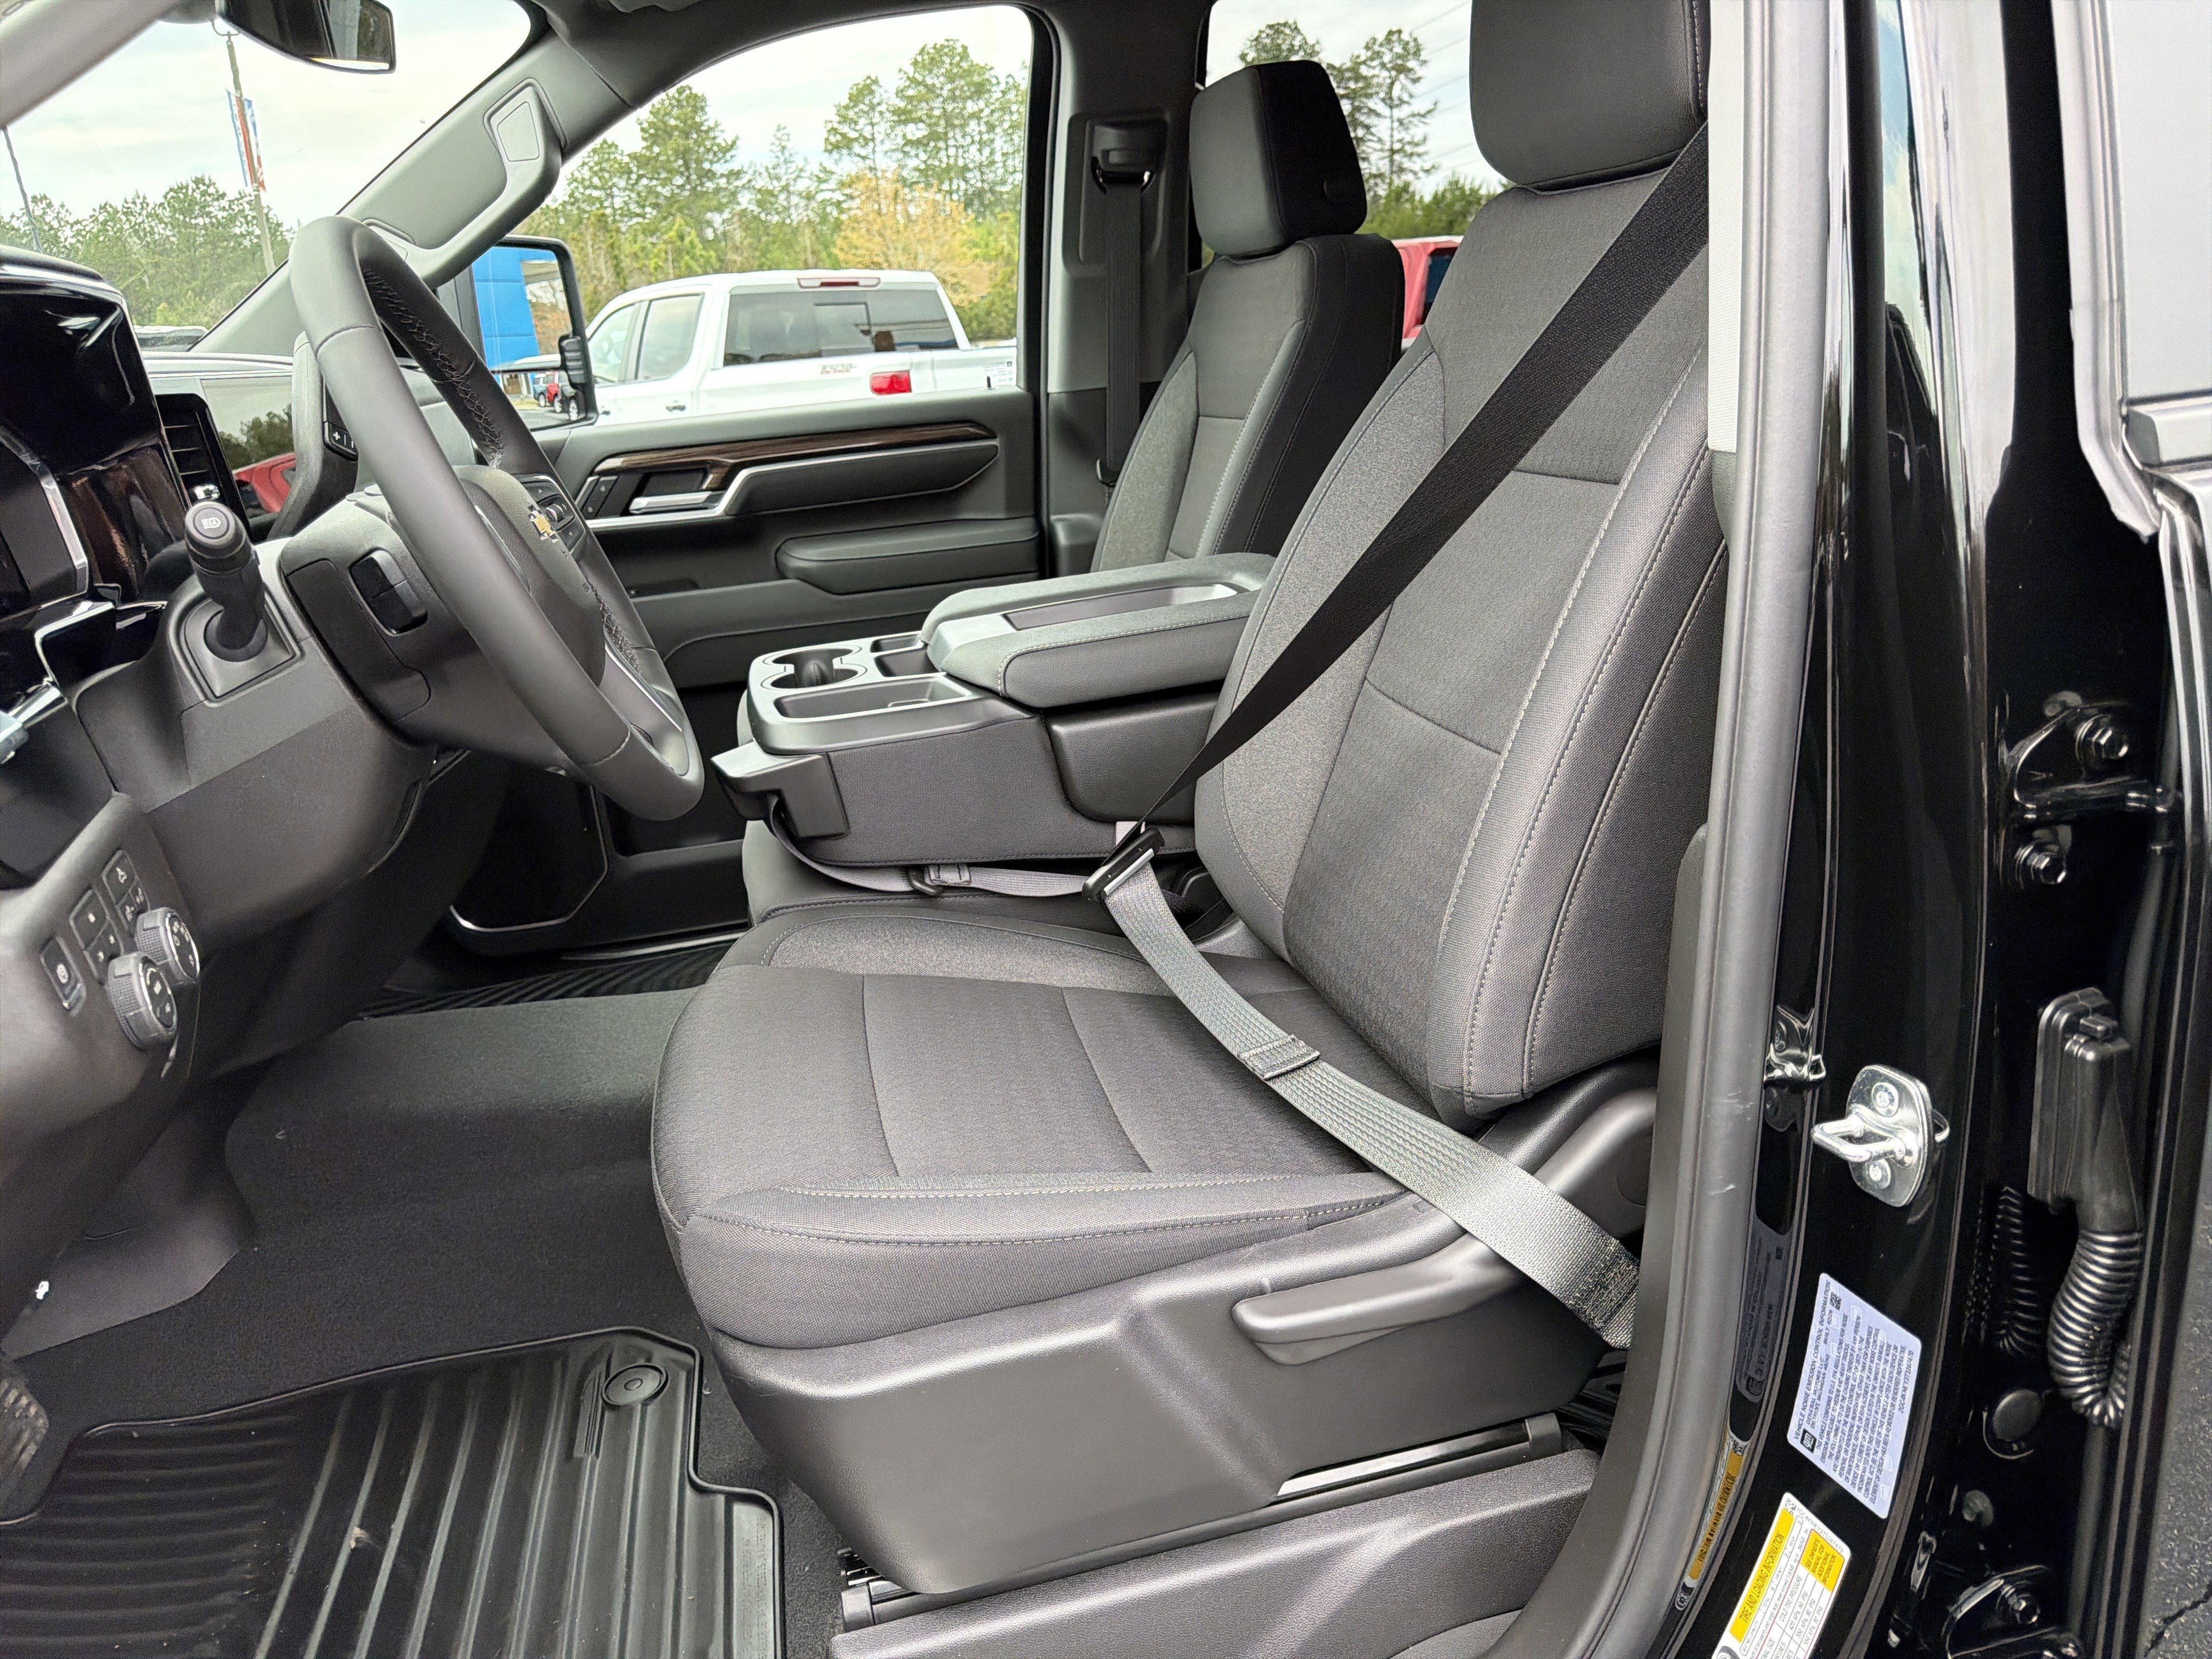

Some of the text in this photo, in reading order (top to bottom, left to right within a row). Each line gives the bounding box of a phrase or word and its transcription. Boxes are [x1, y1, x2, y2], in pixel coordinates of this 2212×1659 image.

[1853, 1314, 1861, 1336] PERSON
[1794, 1279, 1831, 1442] VEHICLE NOISE EMISSION CONTROL INFORMATION
[1806, 1395, 1816, 1426] GENERAL
[1812, 1369, 1821, 1397] MOTORS
[1816, 1370, 1826, 1401] MICHIGAN
[1819, 1419, 1827, 1441] VEHICLE
[1738, 1531, 1785, 1623] TIRE AND LOADING INFORMATION
